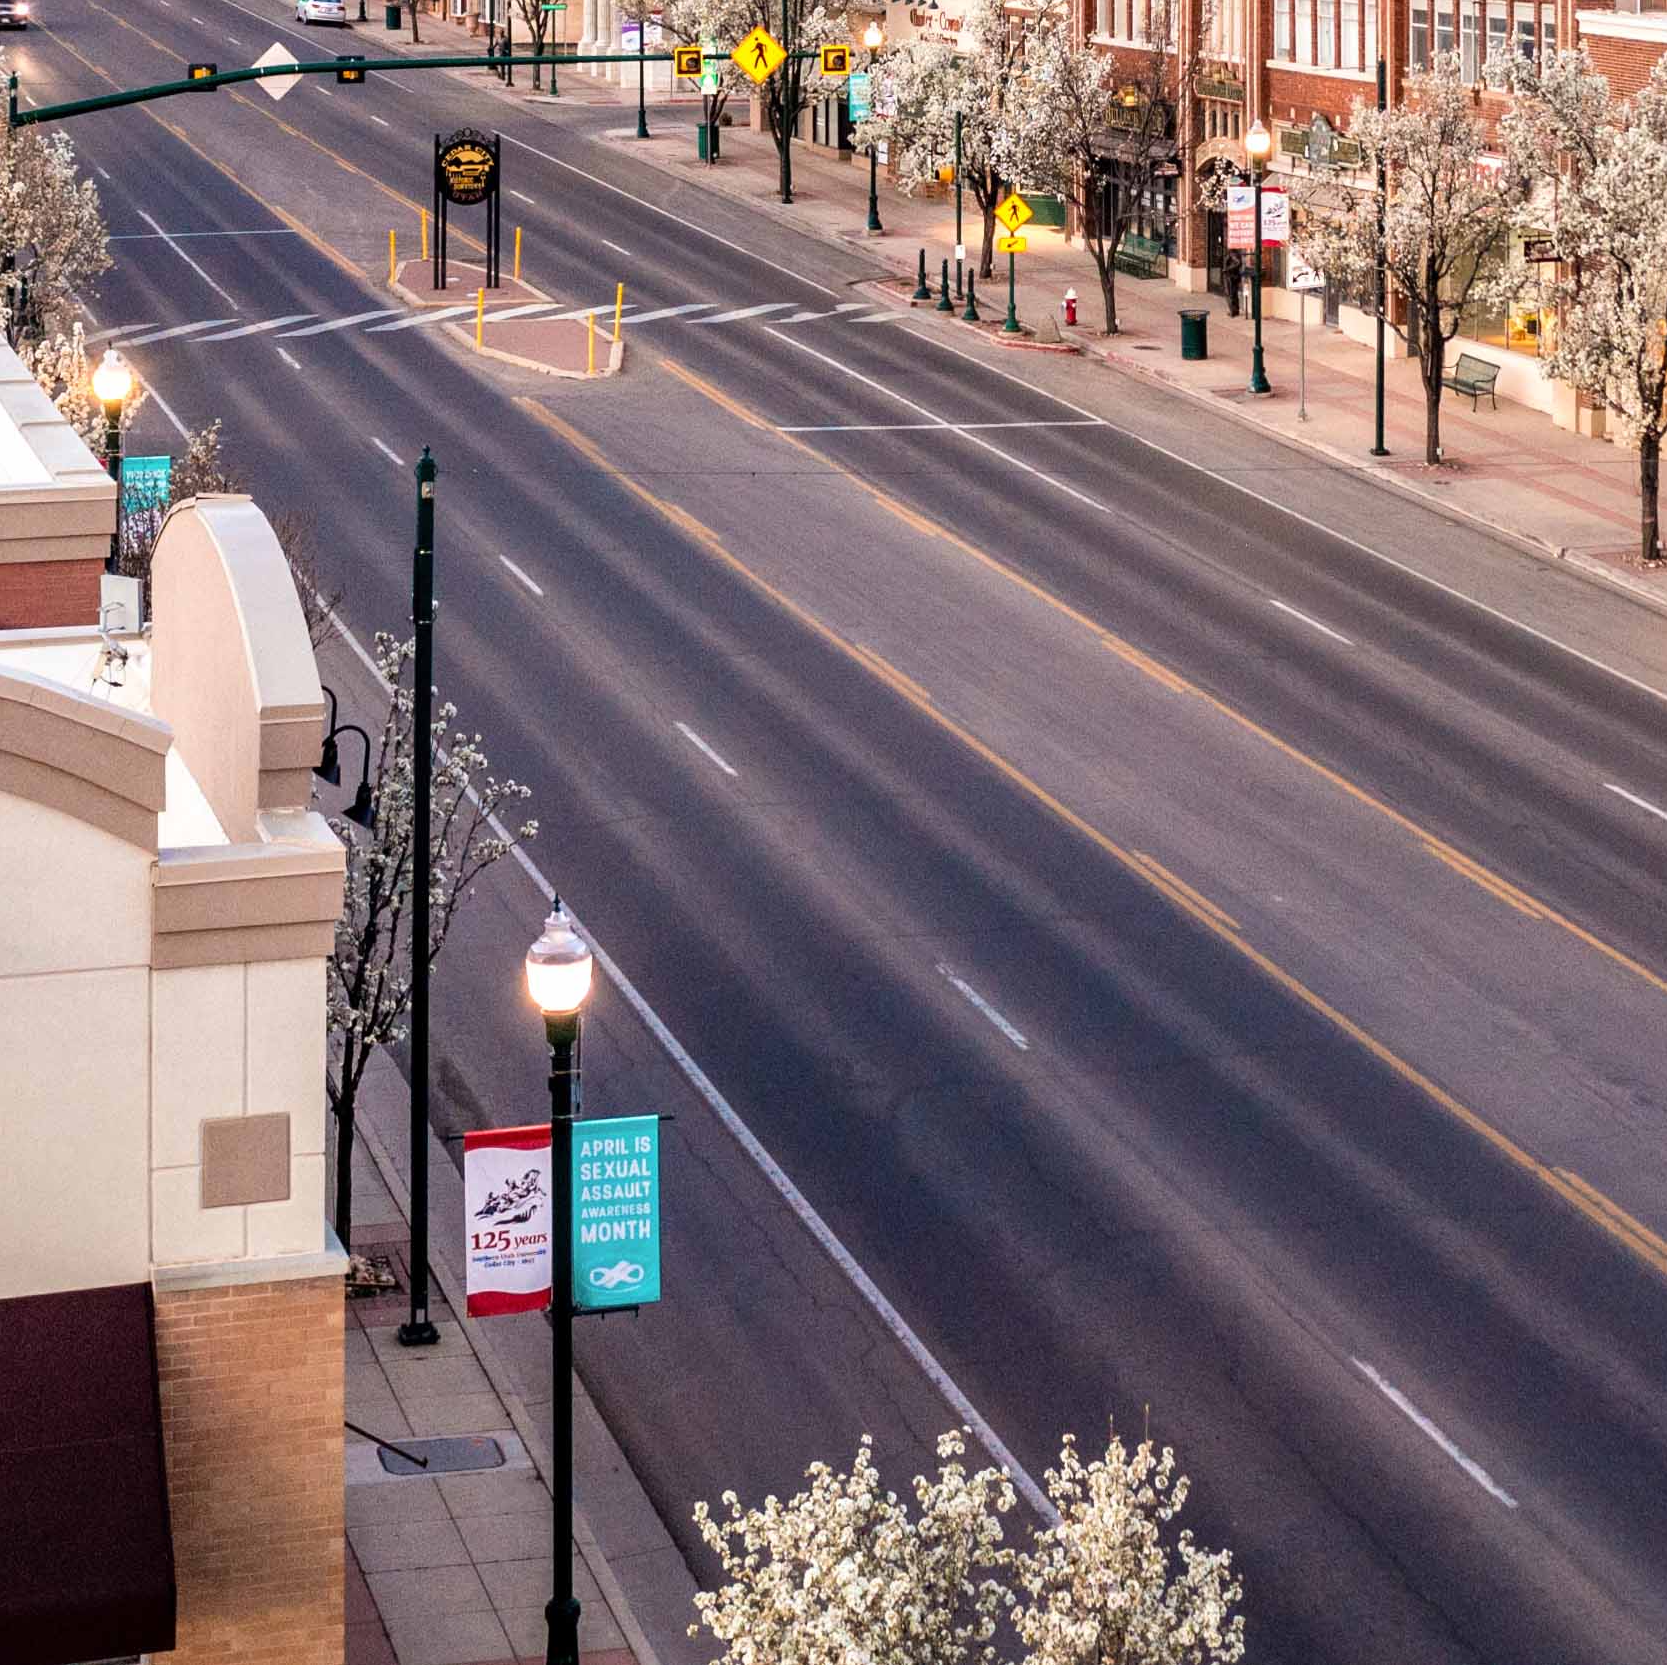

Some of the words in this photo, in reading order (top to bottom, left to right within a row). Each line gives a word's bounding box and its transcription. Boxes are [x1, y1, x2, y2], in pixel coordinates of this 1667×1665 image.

[581, 1138, 628, 1158] APRIL
[635, 1136, 651, 1153] IS
[581, 1159, 651, 1181] SEXUAL
[581, 1181, 651, 1202] ASSAULT
[581, 1203, 651, 1219] AWARENESS
[471, 1230, 511, 1252] 125
[514, 1231, 548, 1250] years
[580, 1219, 651, 1244] MONTH
